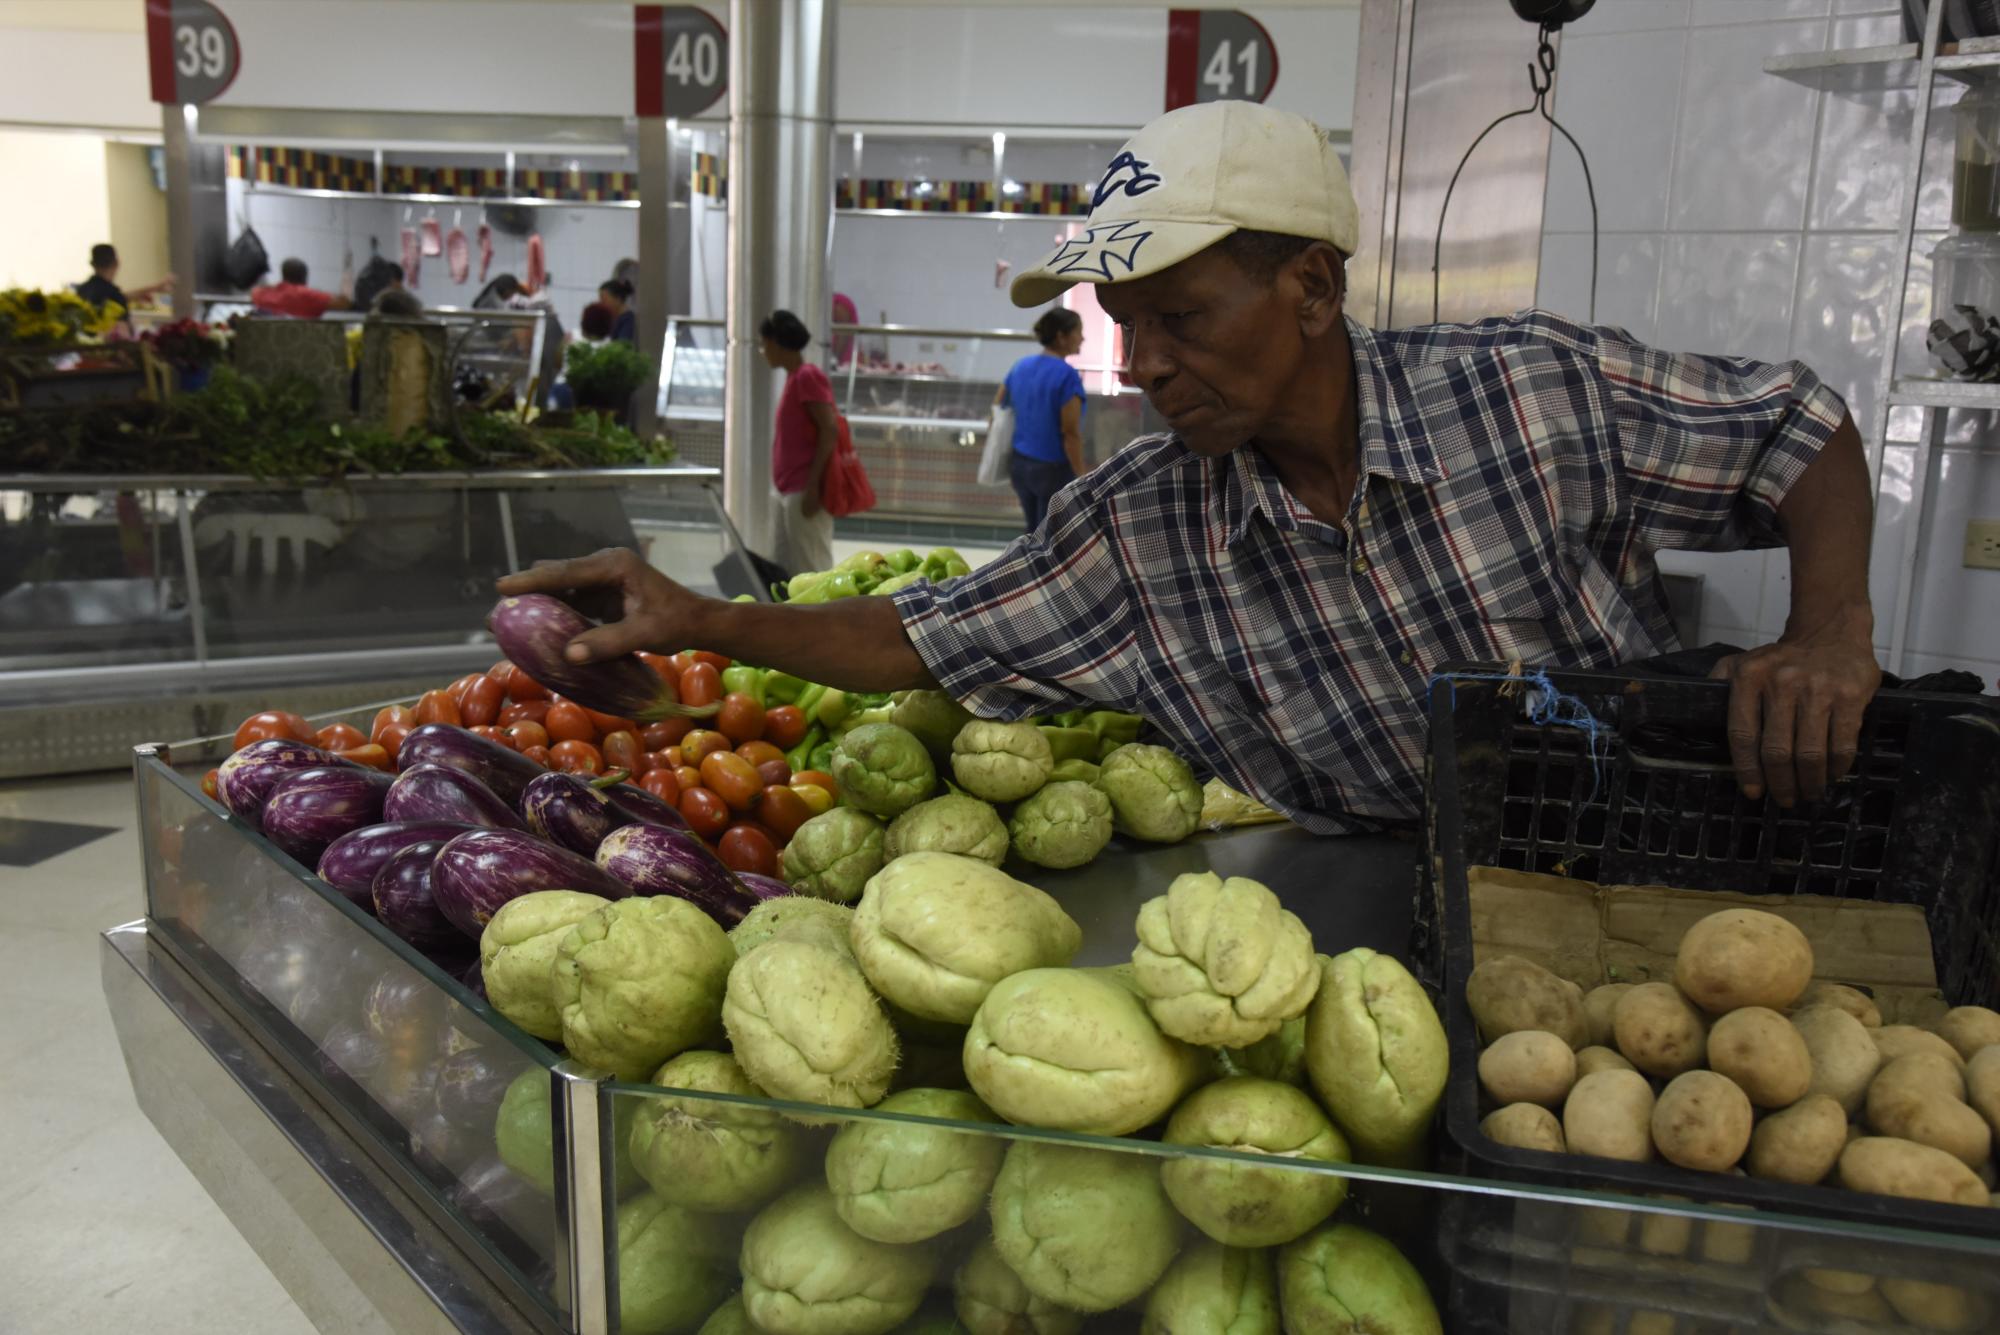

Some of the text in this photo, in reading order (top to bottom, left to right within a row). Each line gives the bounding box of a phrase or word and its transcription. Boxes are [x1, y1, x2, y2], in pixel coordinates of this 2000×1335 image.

[176, 25, 225, 78] 39
[666, 32, 719, 86] 40
[1203, 40, 1257, 95] 41
